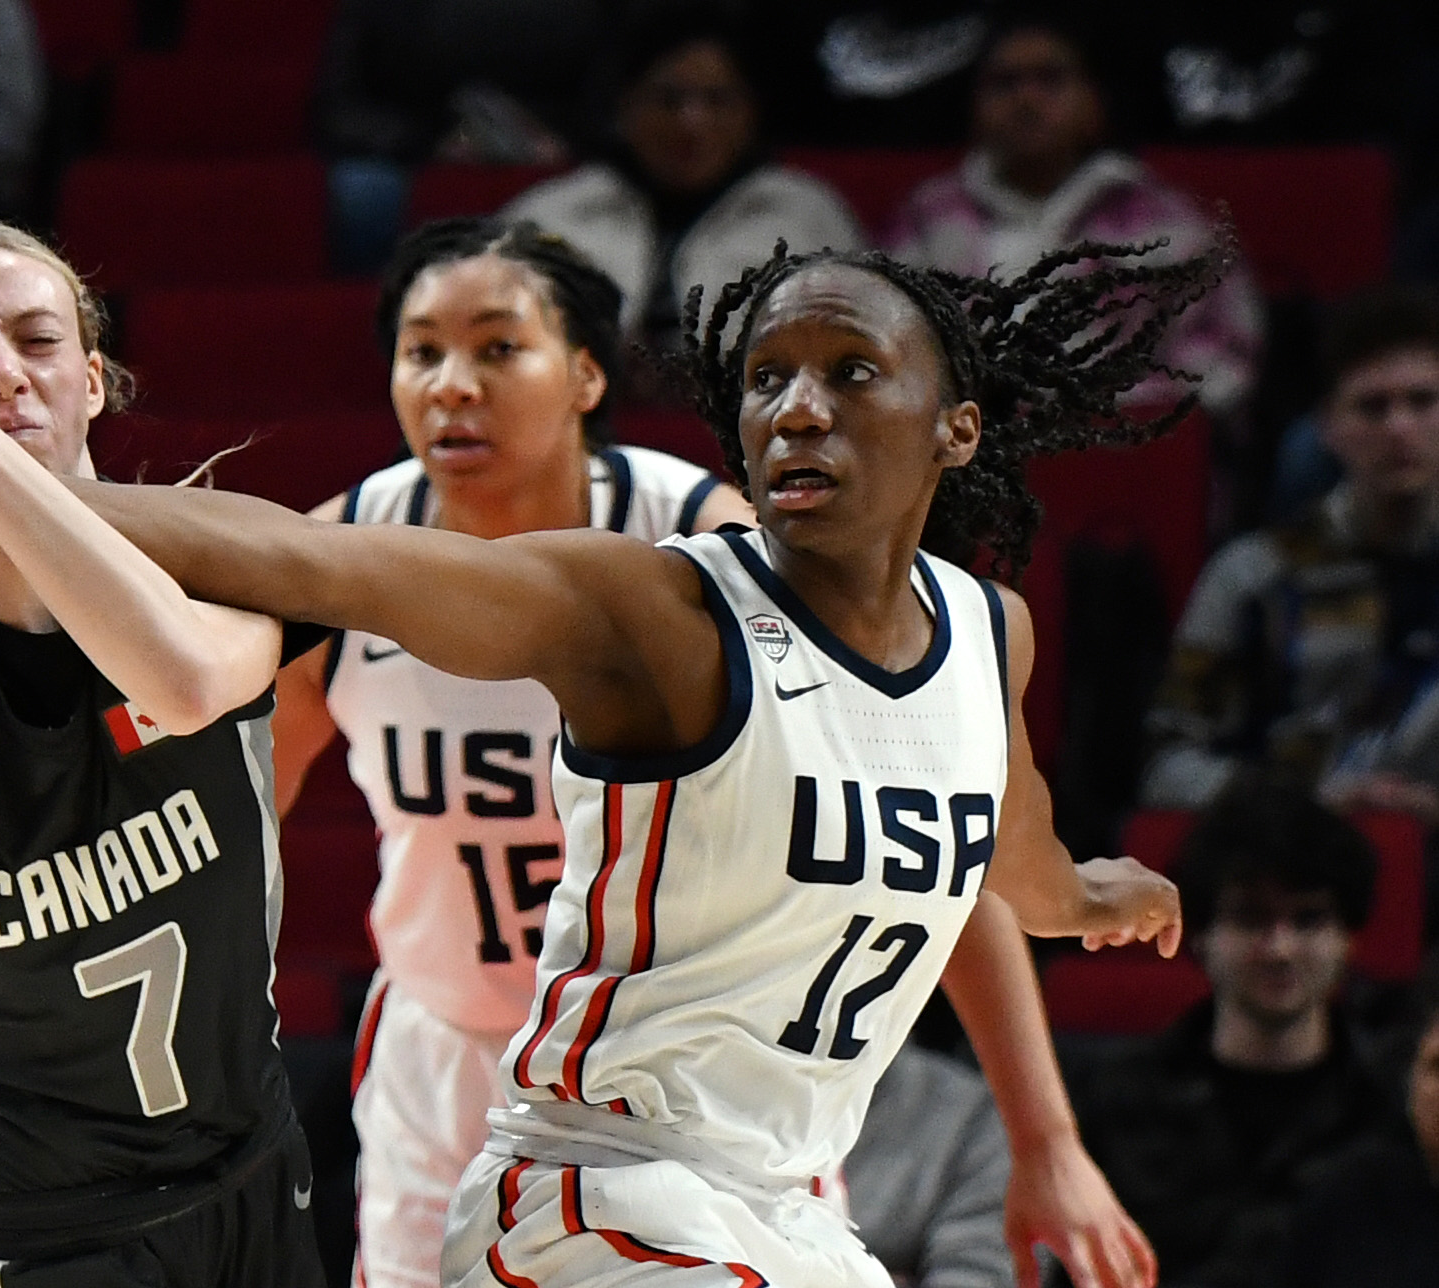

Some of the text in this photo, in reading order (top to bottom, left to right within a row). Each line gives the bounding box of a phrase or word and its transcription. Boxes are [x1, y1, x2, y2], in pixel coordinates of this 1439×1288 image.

[385, 726, 561, 819] US
[787, 775, 995, 897] USA
[459, 844, 558, 964] 15
[73, 921, 188, 1118] 7
[777, 914, 930, 1060] 12
